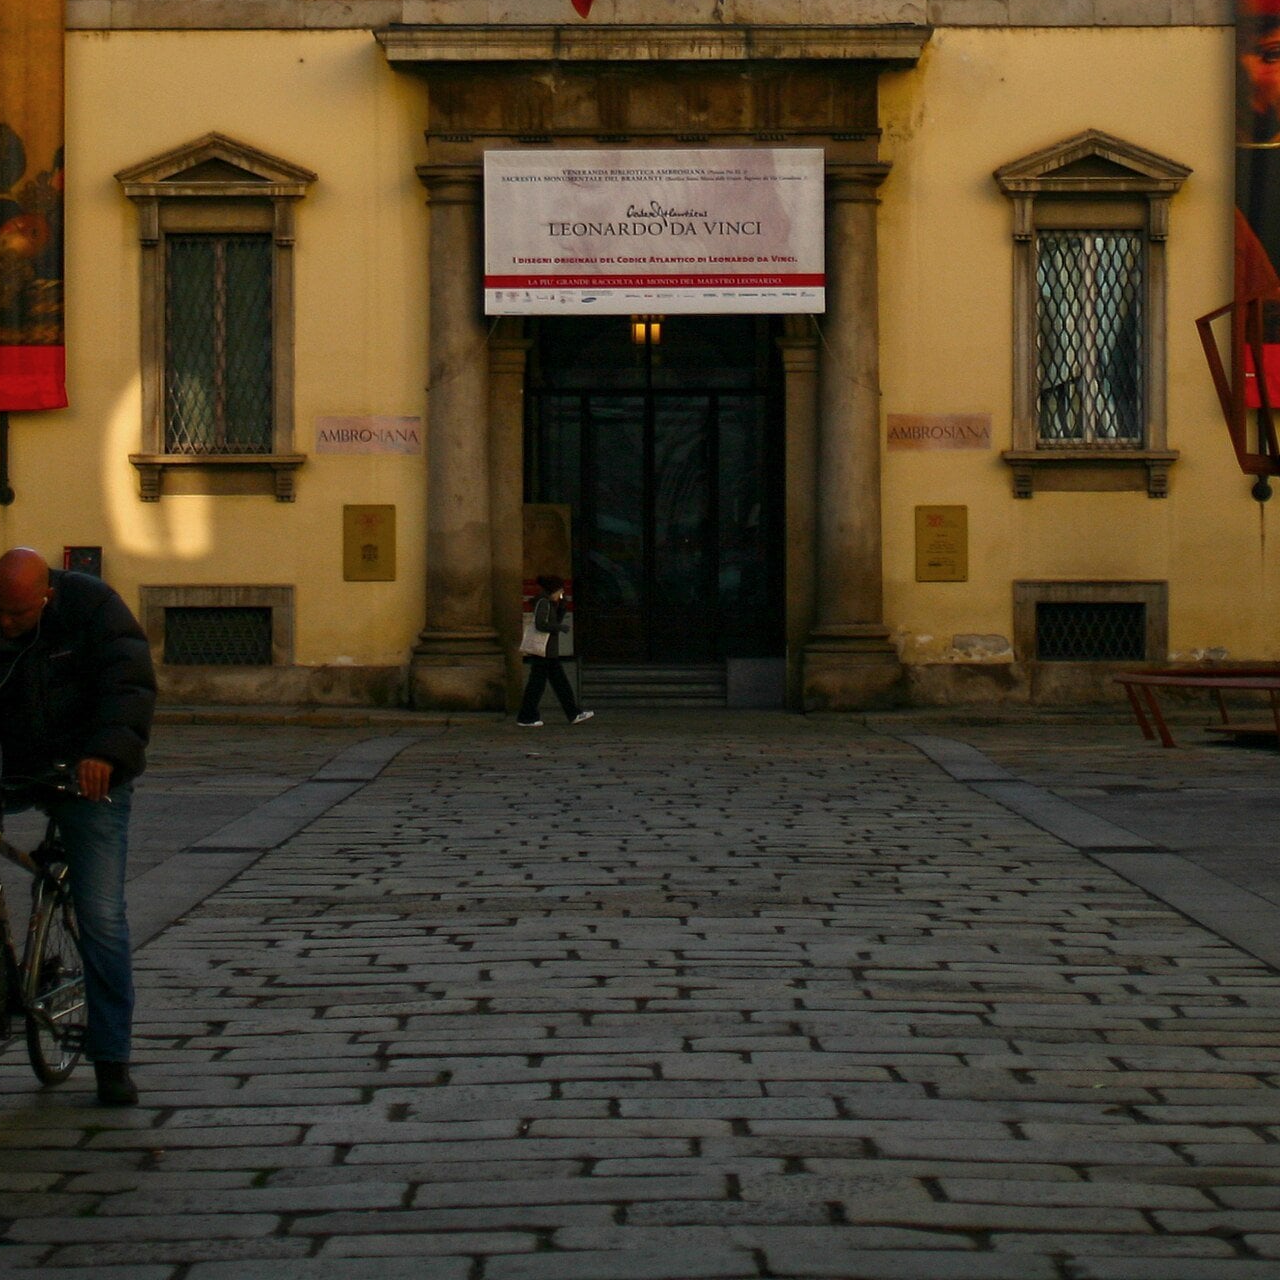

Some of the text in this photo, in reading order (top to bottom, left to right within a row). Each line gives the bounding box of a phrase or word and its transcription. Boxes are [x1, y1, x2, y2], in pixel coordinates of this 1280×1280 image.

[548, 221, 762, 237] LEONARDO DA VINCI
[617, 256, 647, 264] CODICE
[709, 255, 755, 263] LEONARDO
[756, 255, 769, 263] DA
[697, 277, 736, 285] MAESTRO
[318, 428, 419, 444] AMBROSIANA
[888, 425, 990, 440] AMBROSIANA
